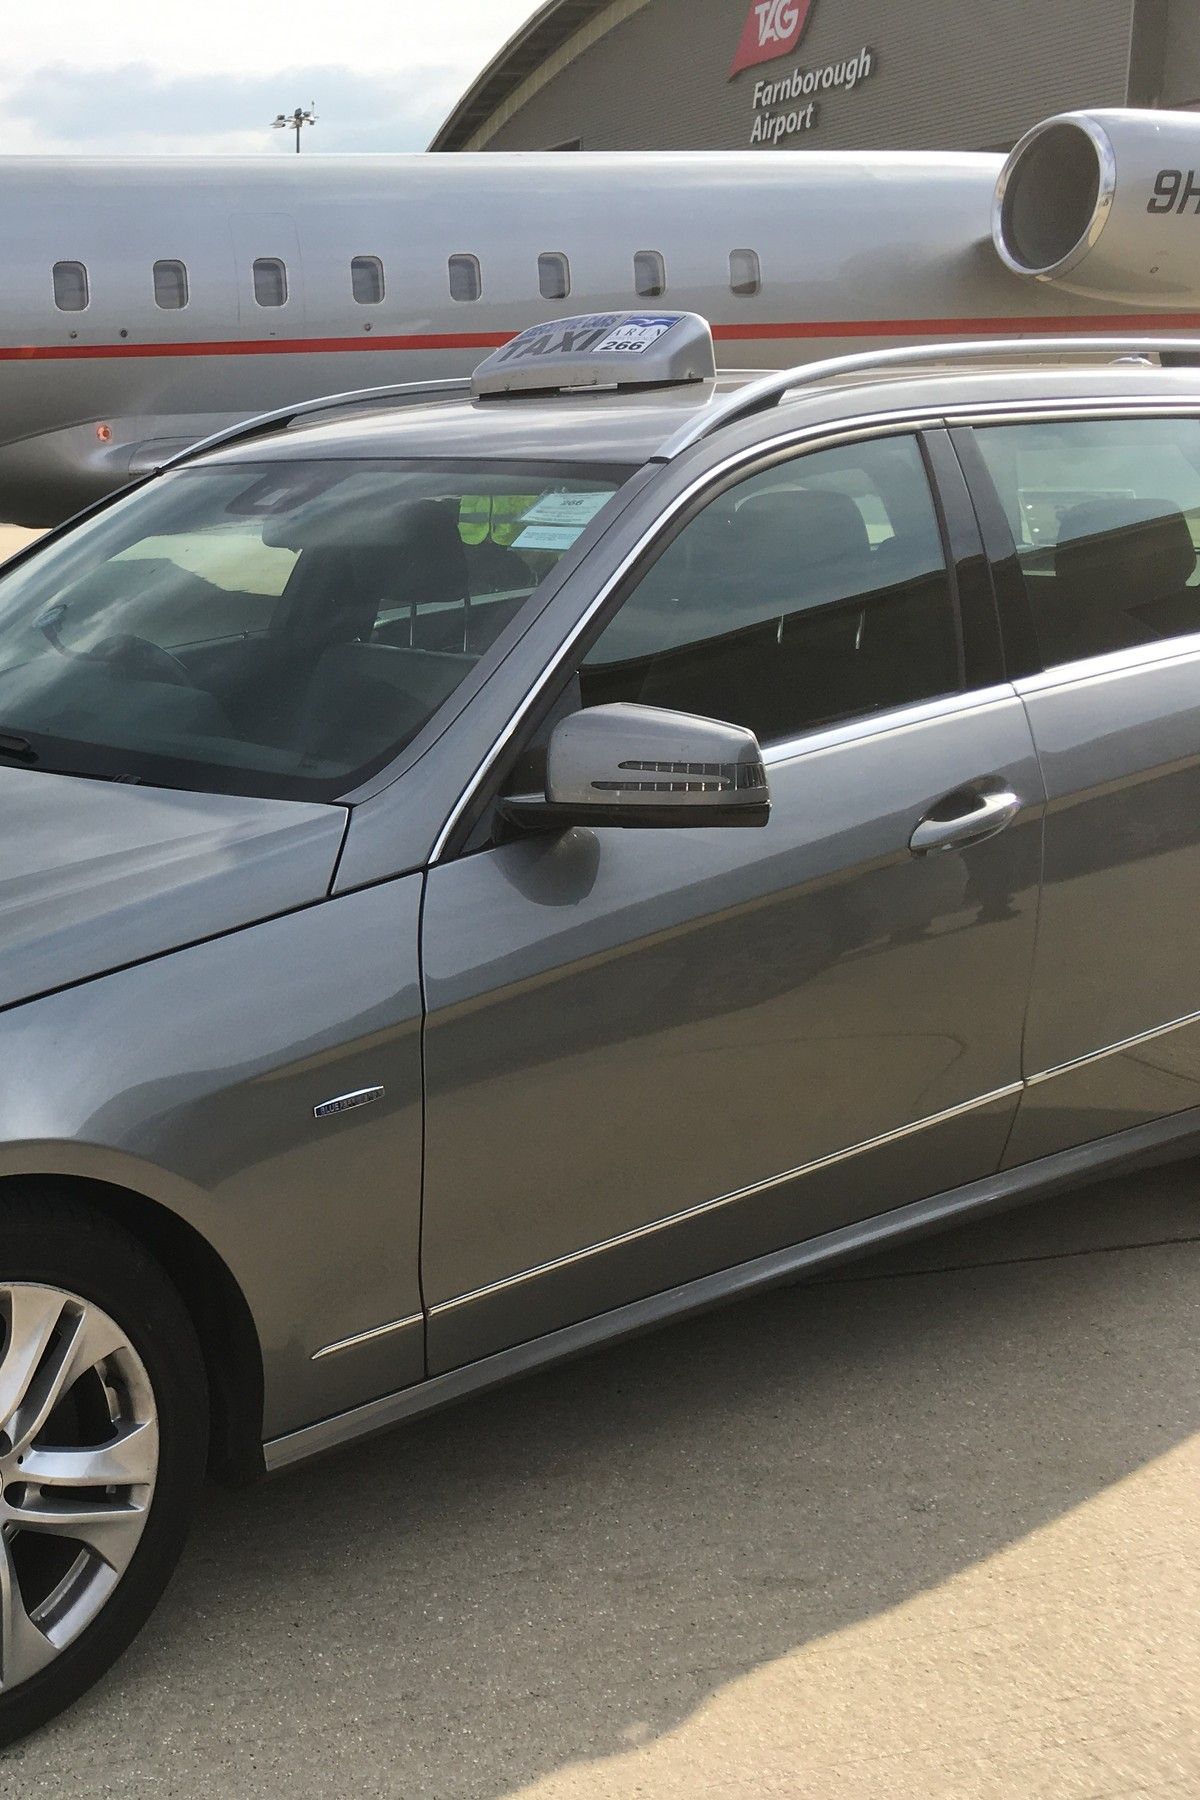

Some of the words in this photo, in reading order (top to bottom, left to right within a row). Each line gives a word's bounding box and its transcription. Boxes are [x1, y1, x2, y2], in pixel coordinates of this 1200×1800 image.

[754, 0, 799, 47] TAG
[752, 46, 871, 109] Farnborough
[750, 101, 814, 145] Airport
[497, 328, 608, 363] TAXI
[600, 341, 645, 350] 266
